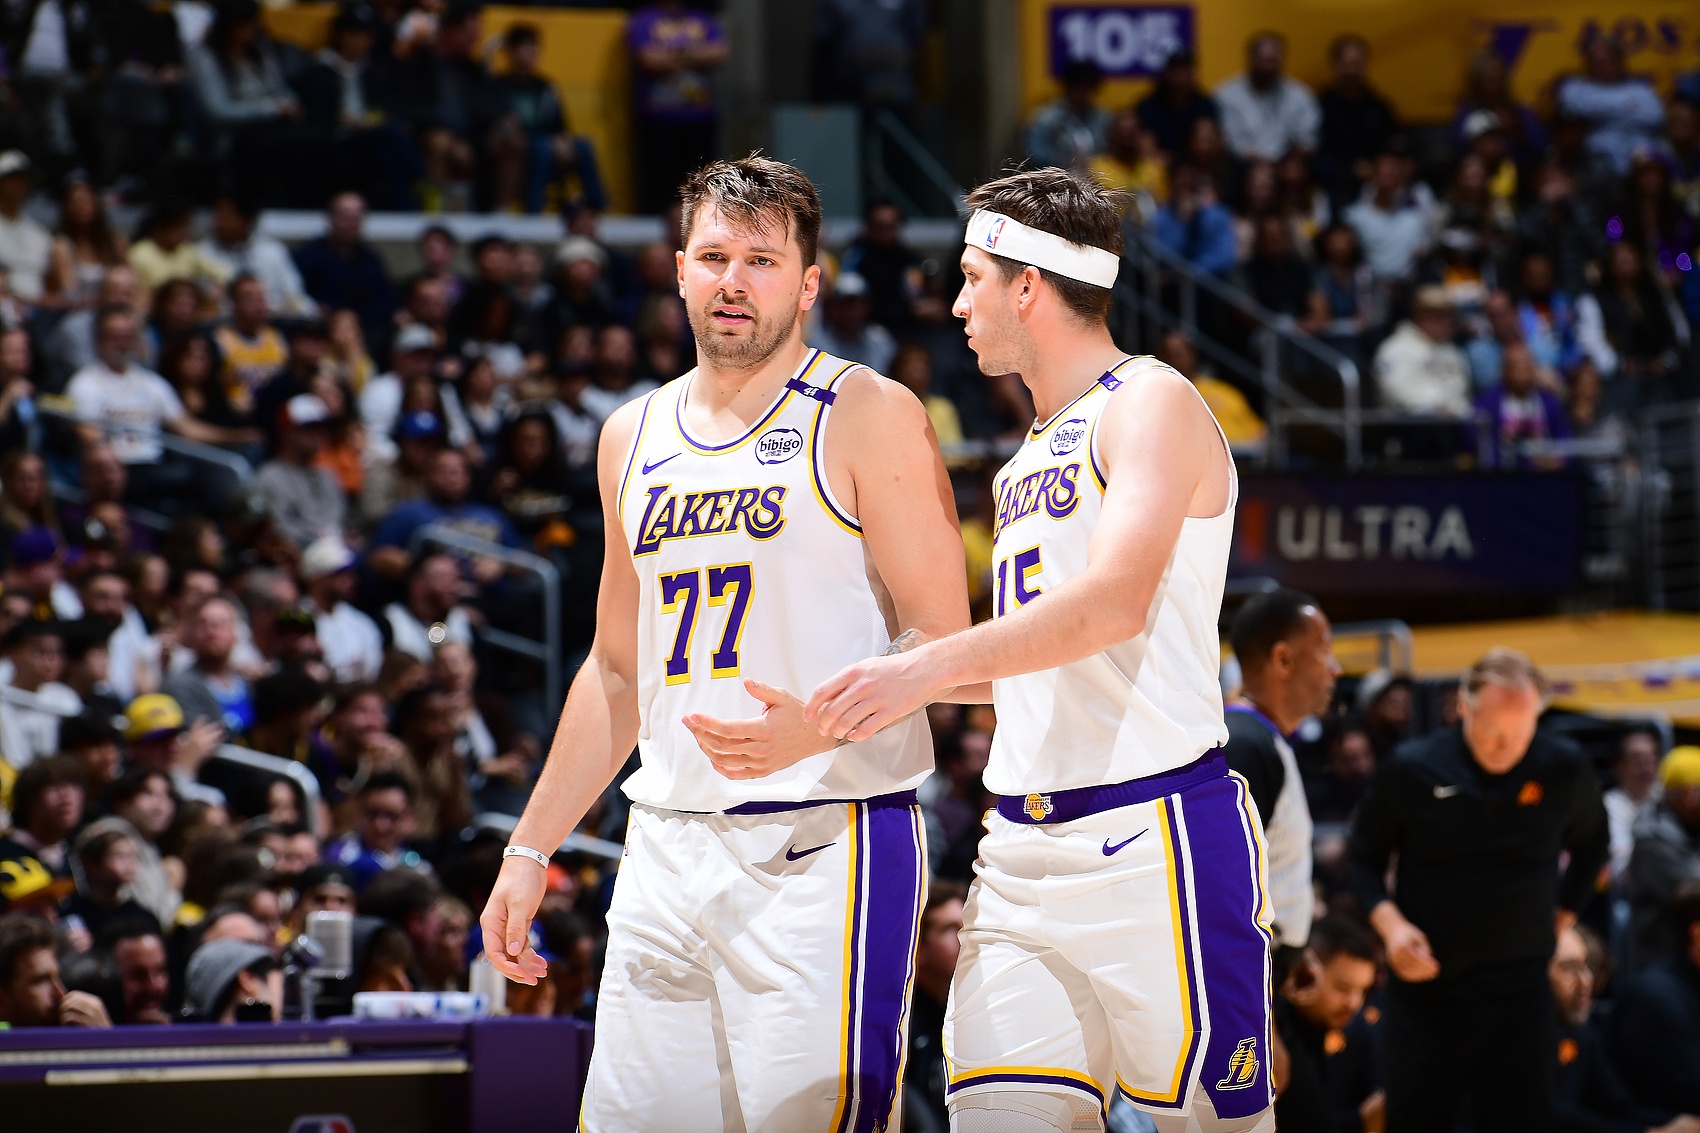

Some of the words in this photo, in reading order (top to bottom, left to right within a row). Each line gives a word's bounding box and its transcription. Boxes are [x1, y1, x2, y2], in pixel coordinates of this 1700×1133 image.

[1059, 12, 1184, 71] 105
[760, 437, 800, 452] bibigo
[1054, 428, 1084, 443] bibigo
[633, 483, 790, 559] LAKERS
[1277, 504, 1475, 561] ULTRA
[996, 544, 1045, 617] 15
[658, 561, 756, 686] 77
